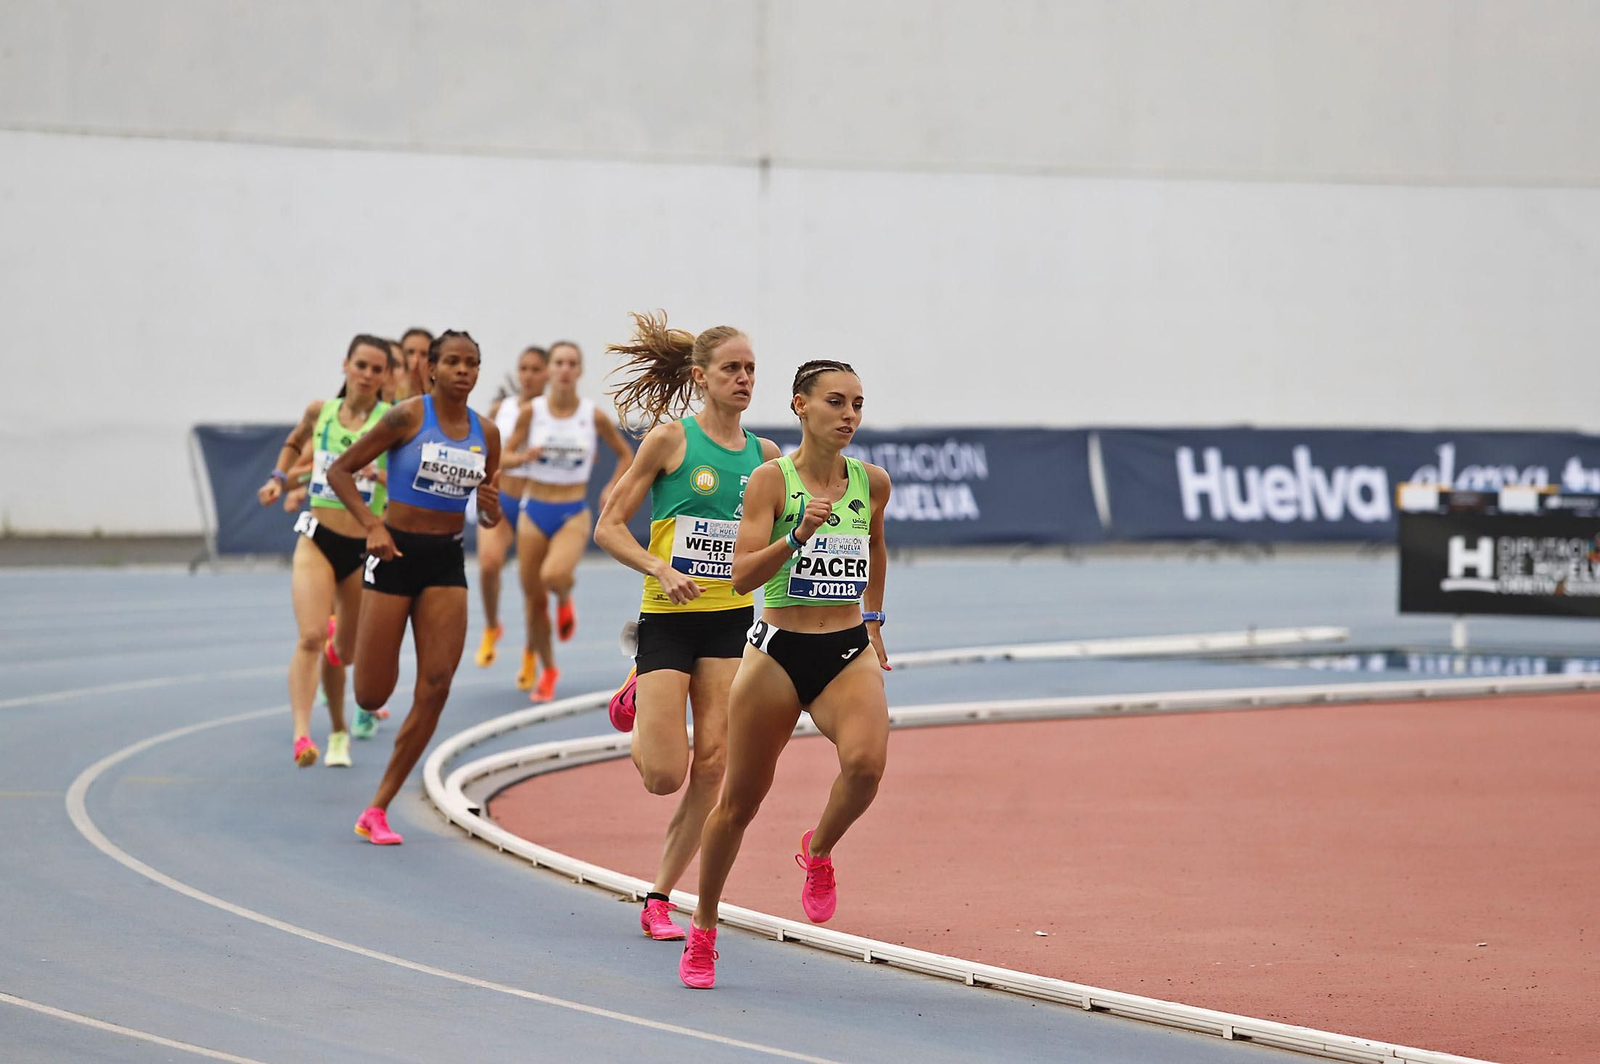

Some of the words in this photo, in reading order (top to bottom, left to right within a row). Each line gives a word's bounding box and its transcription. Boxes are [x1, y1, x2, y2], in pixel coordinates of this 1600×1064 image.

[1175, 444, 1392, 522] Huelva
[709, 522, 739, 530] DIPUTACIÓ
[719, 528, 737, 536] HUEL
[685, 536, 736, 553] WEBE
[829, 537, 863, 545] DIPUTACIÓN
[706, 552, 726, 561] 113
[688, 561, 732, 576] Joma
[795, 556, 868, 578] PACER
[809, 581, 858, 596] Joma
